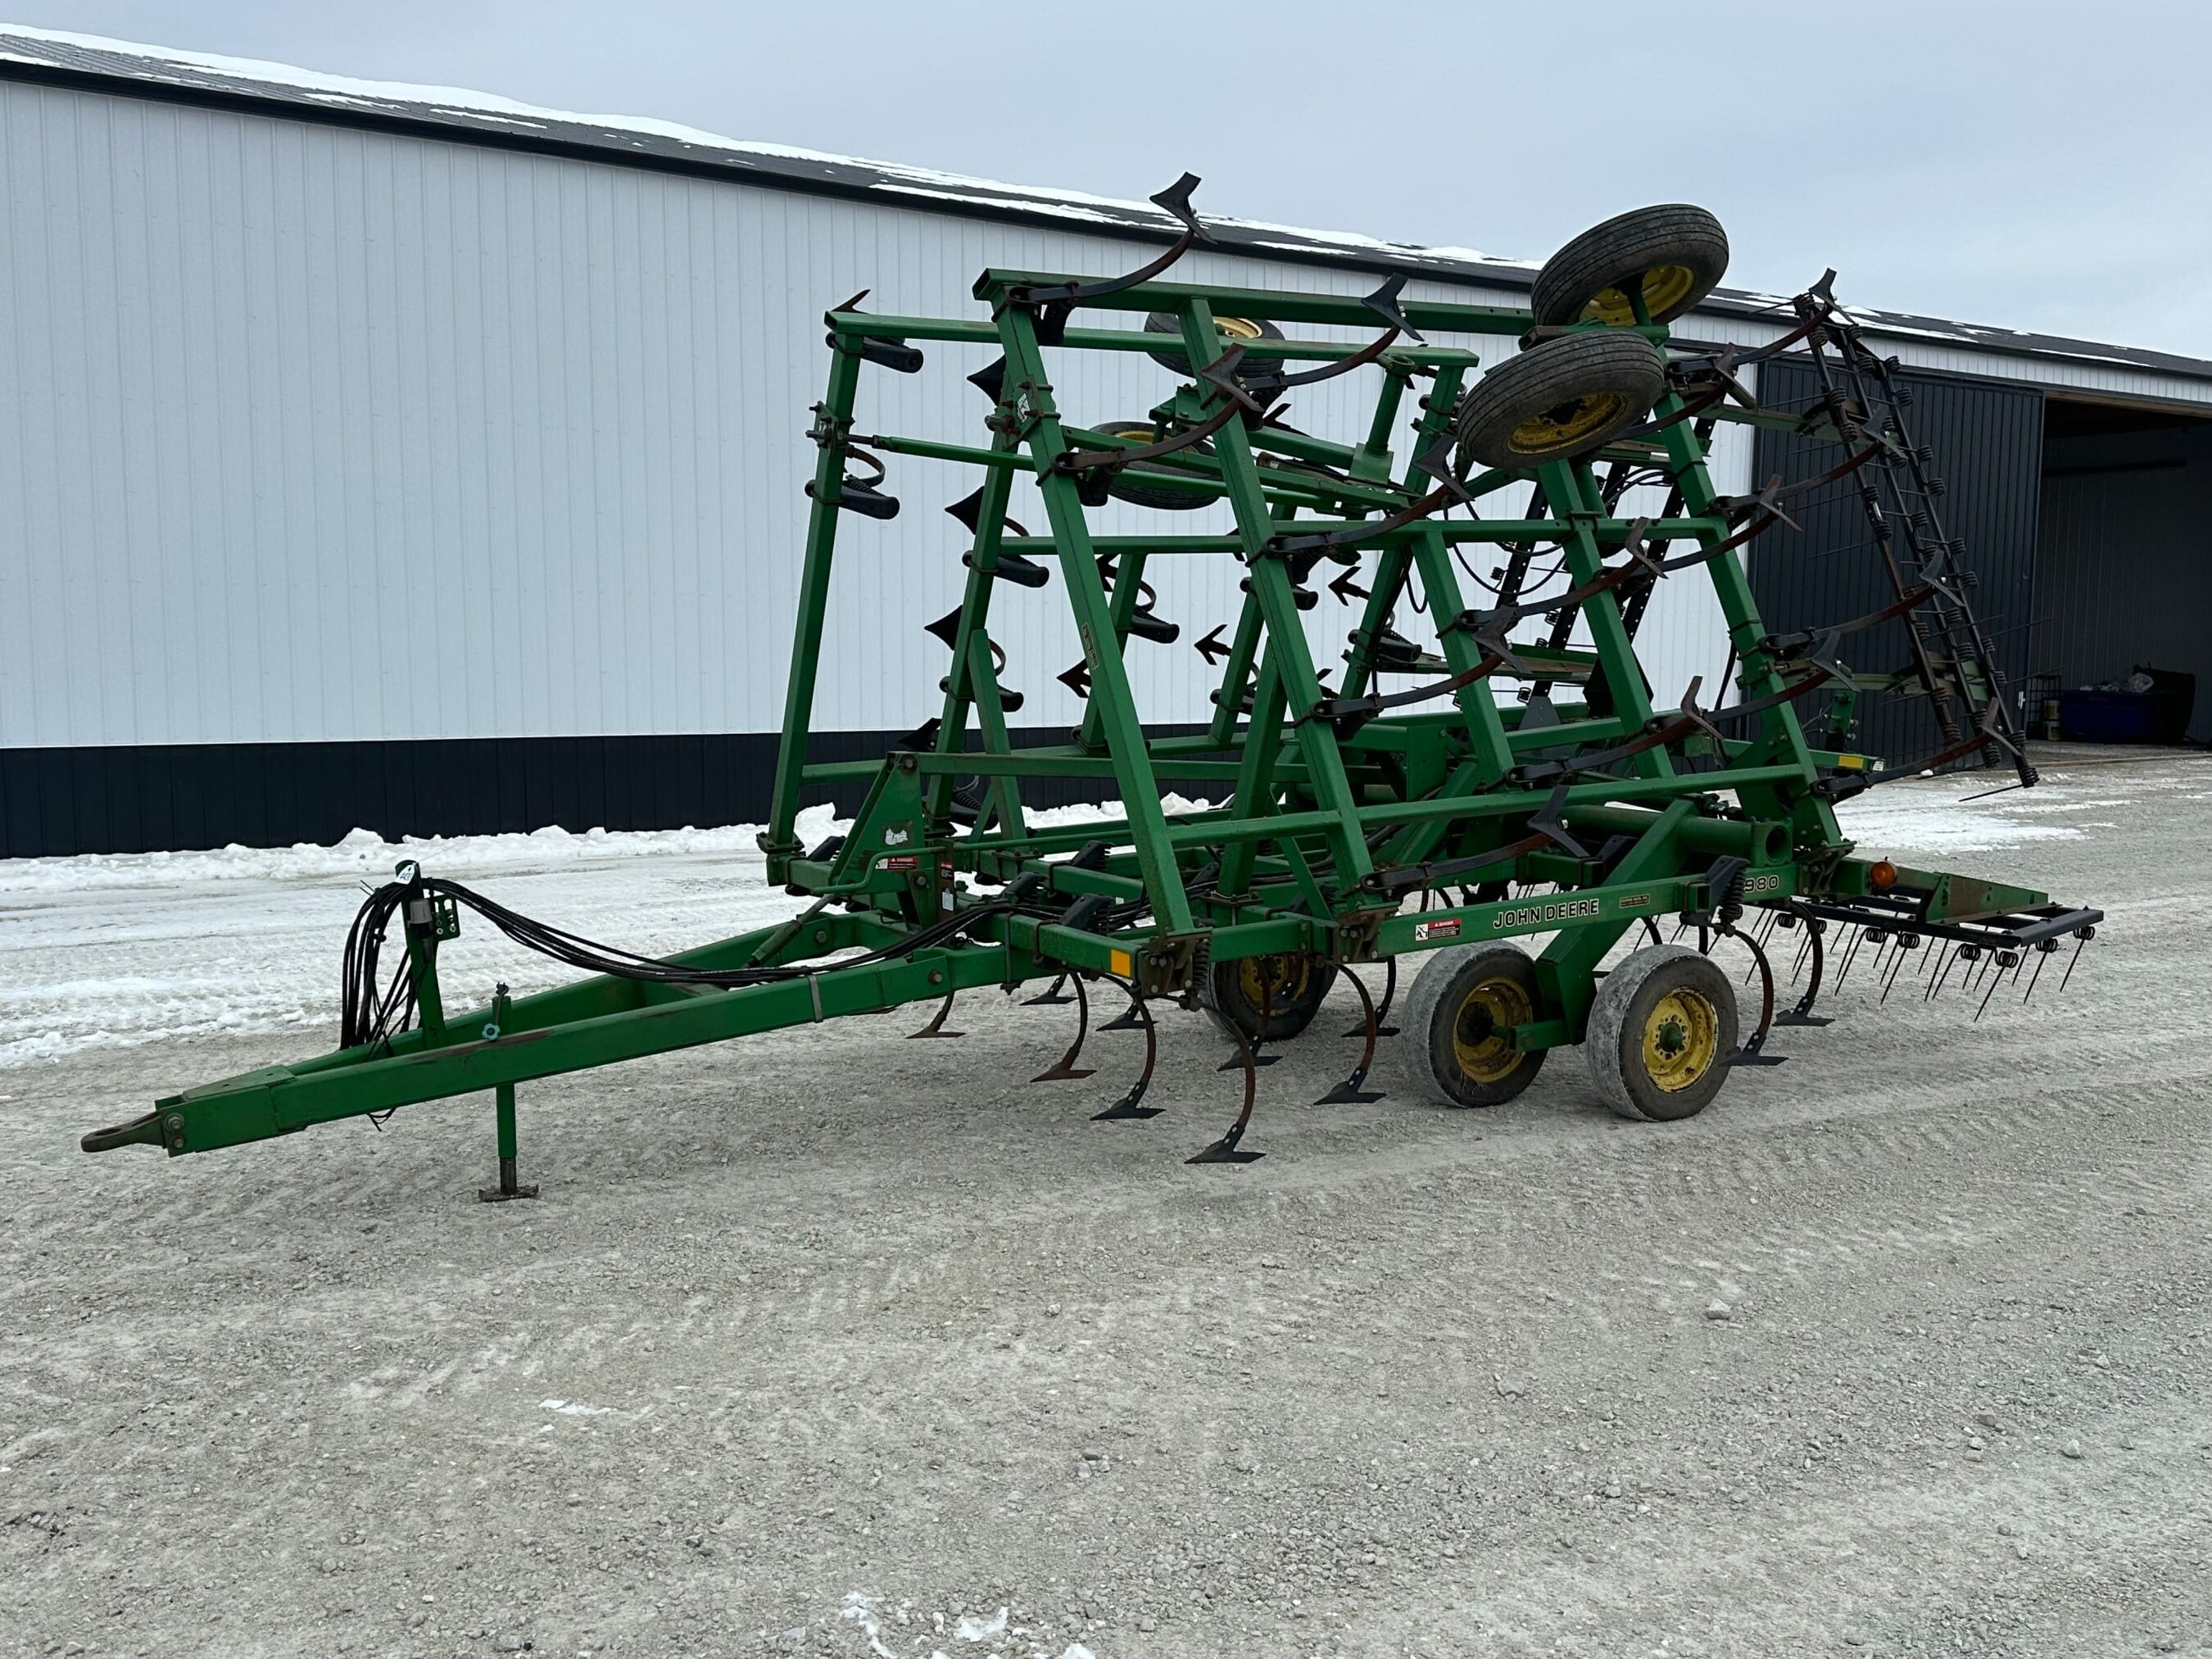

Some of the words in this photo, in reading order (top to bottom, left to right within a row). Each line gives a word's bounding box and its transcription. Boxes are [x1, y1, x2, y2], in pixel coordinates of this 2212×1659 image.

[1744, 874, 1779, 893] 980
[1493, 906, 1541, 929] JOHN
[1545, 898, 1599, 922] DEERE
